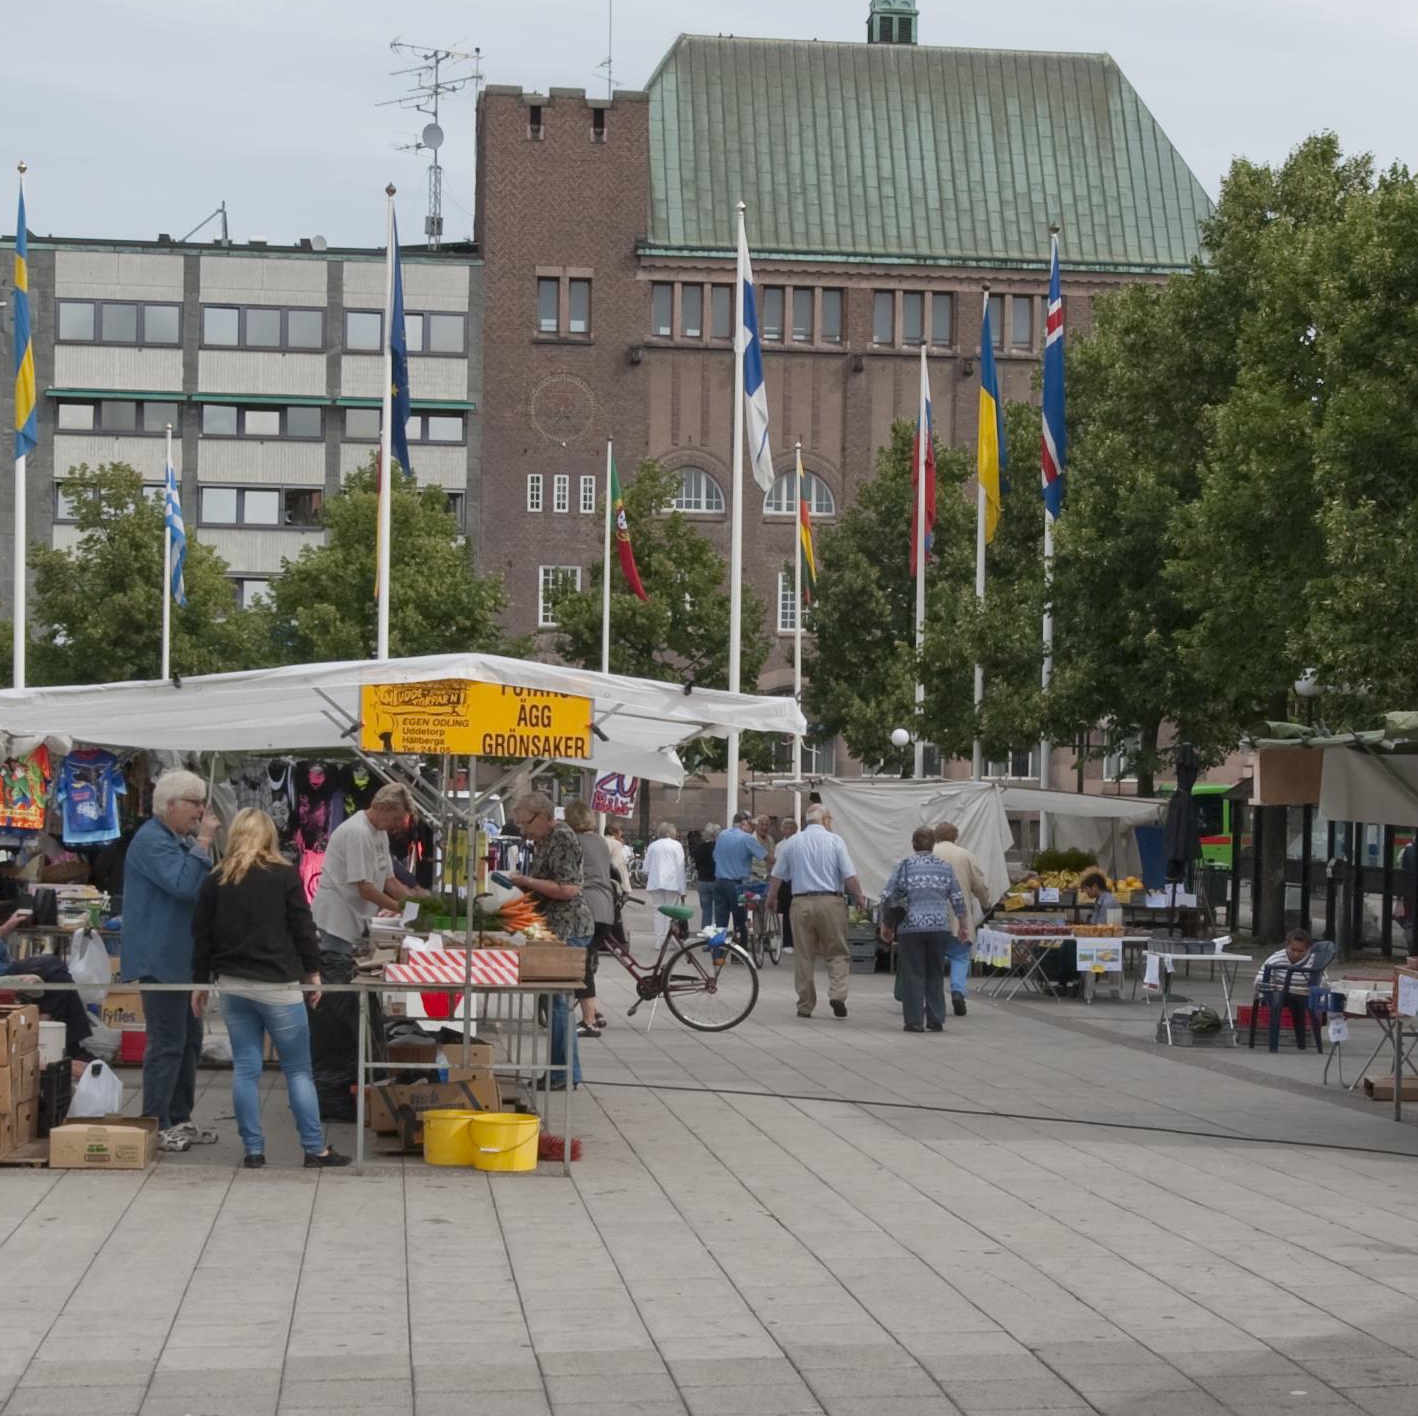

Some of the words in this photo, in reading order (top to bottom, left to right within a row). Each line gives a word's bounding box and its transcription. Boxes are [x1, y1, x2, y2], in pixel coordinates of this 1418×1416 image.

[403, 717, 430, 726] EGEN
[432, 718, 470, 728] ODLING
[517, 698, 552, 728] ÄGG
[402, 727, 445, 737] Uddetorp
[482, 728, 585, 759] GRÖNSAKER
